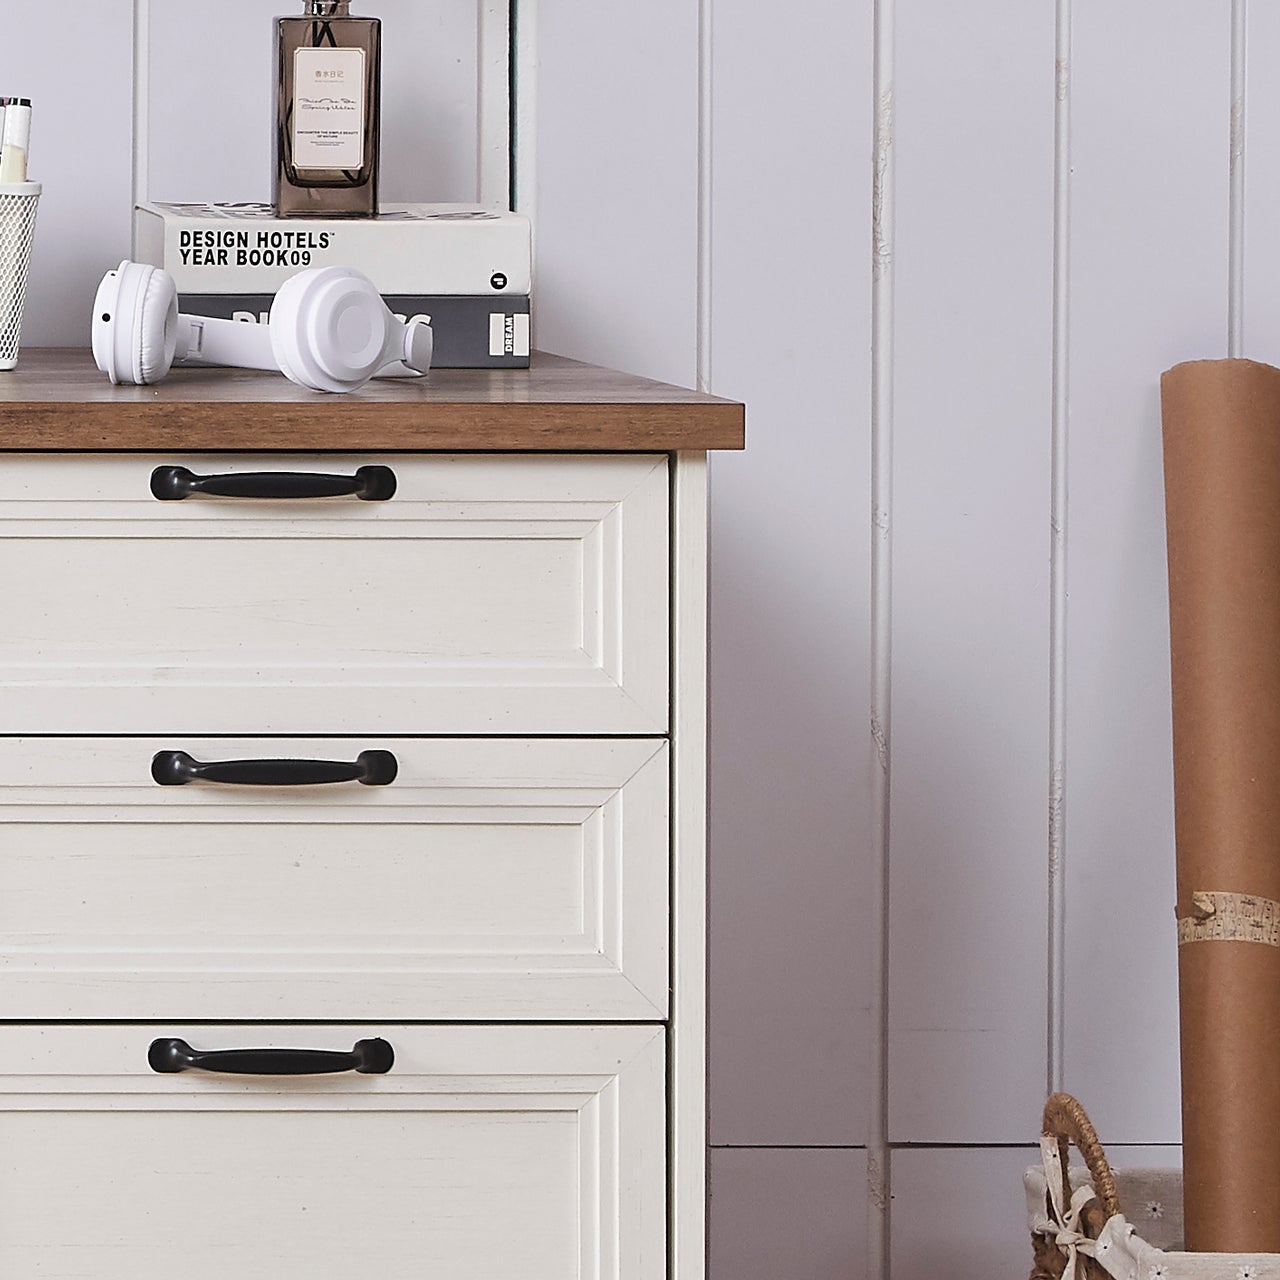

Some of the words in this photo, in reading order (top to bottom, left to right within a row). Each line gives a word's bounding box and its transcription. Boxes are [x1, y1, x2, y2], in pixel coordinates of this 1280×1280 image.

[180, 231, 249, 248] DESIGN
[180, 249, 228, 265] YEAR
[505, 317, 513, 352] DREAM
